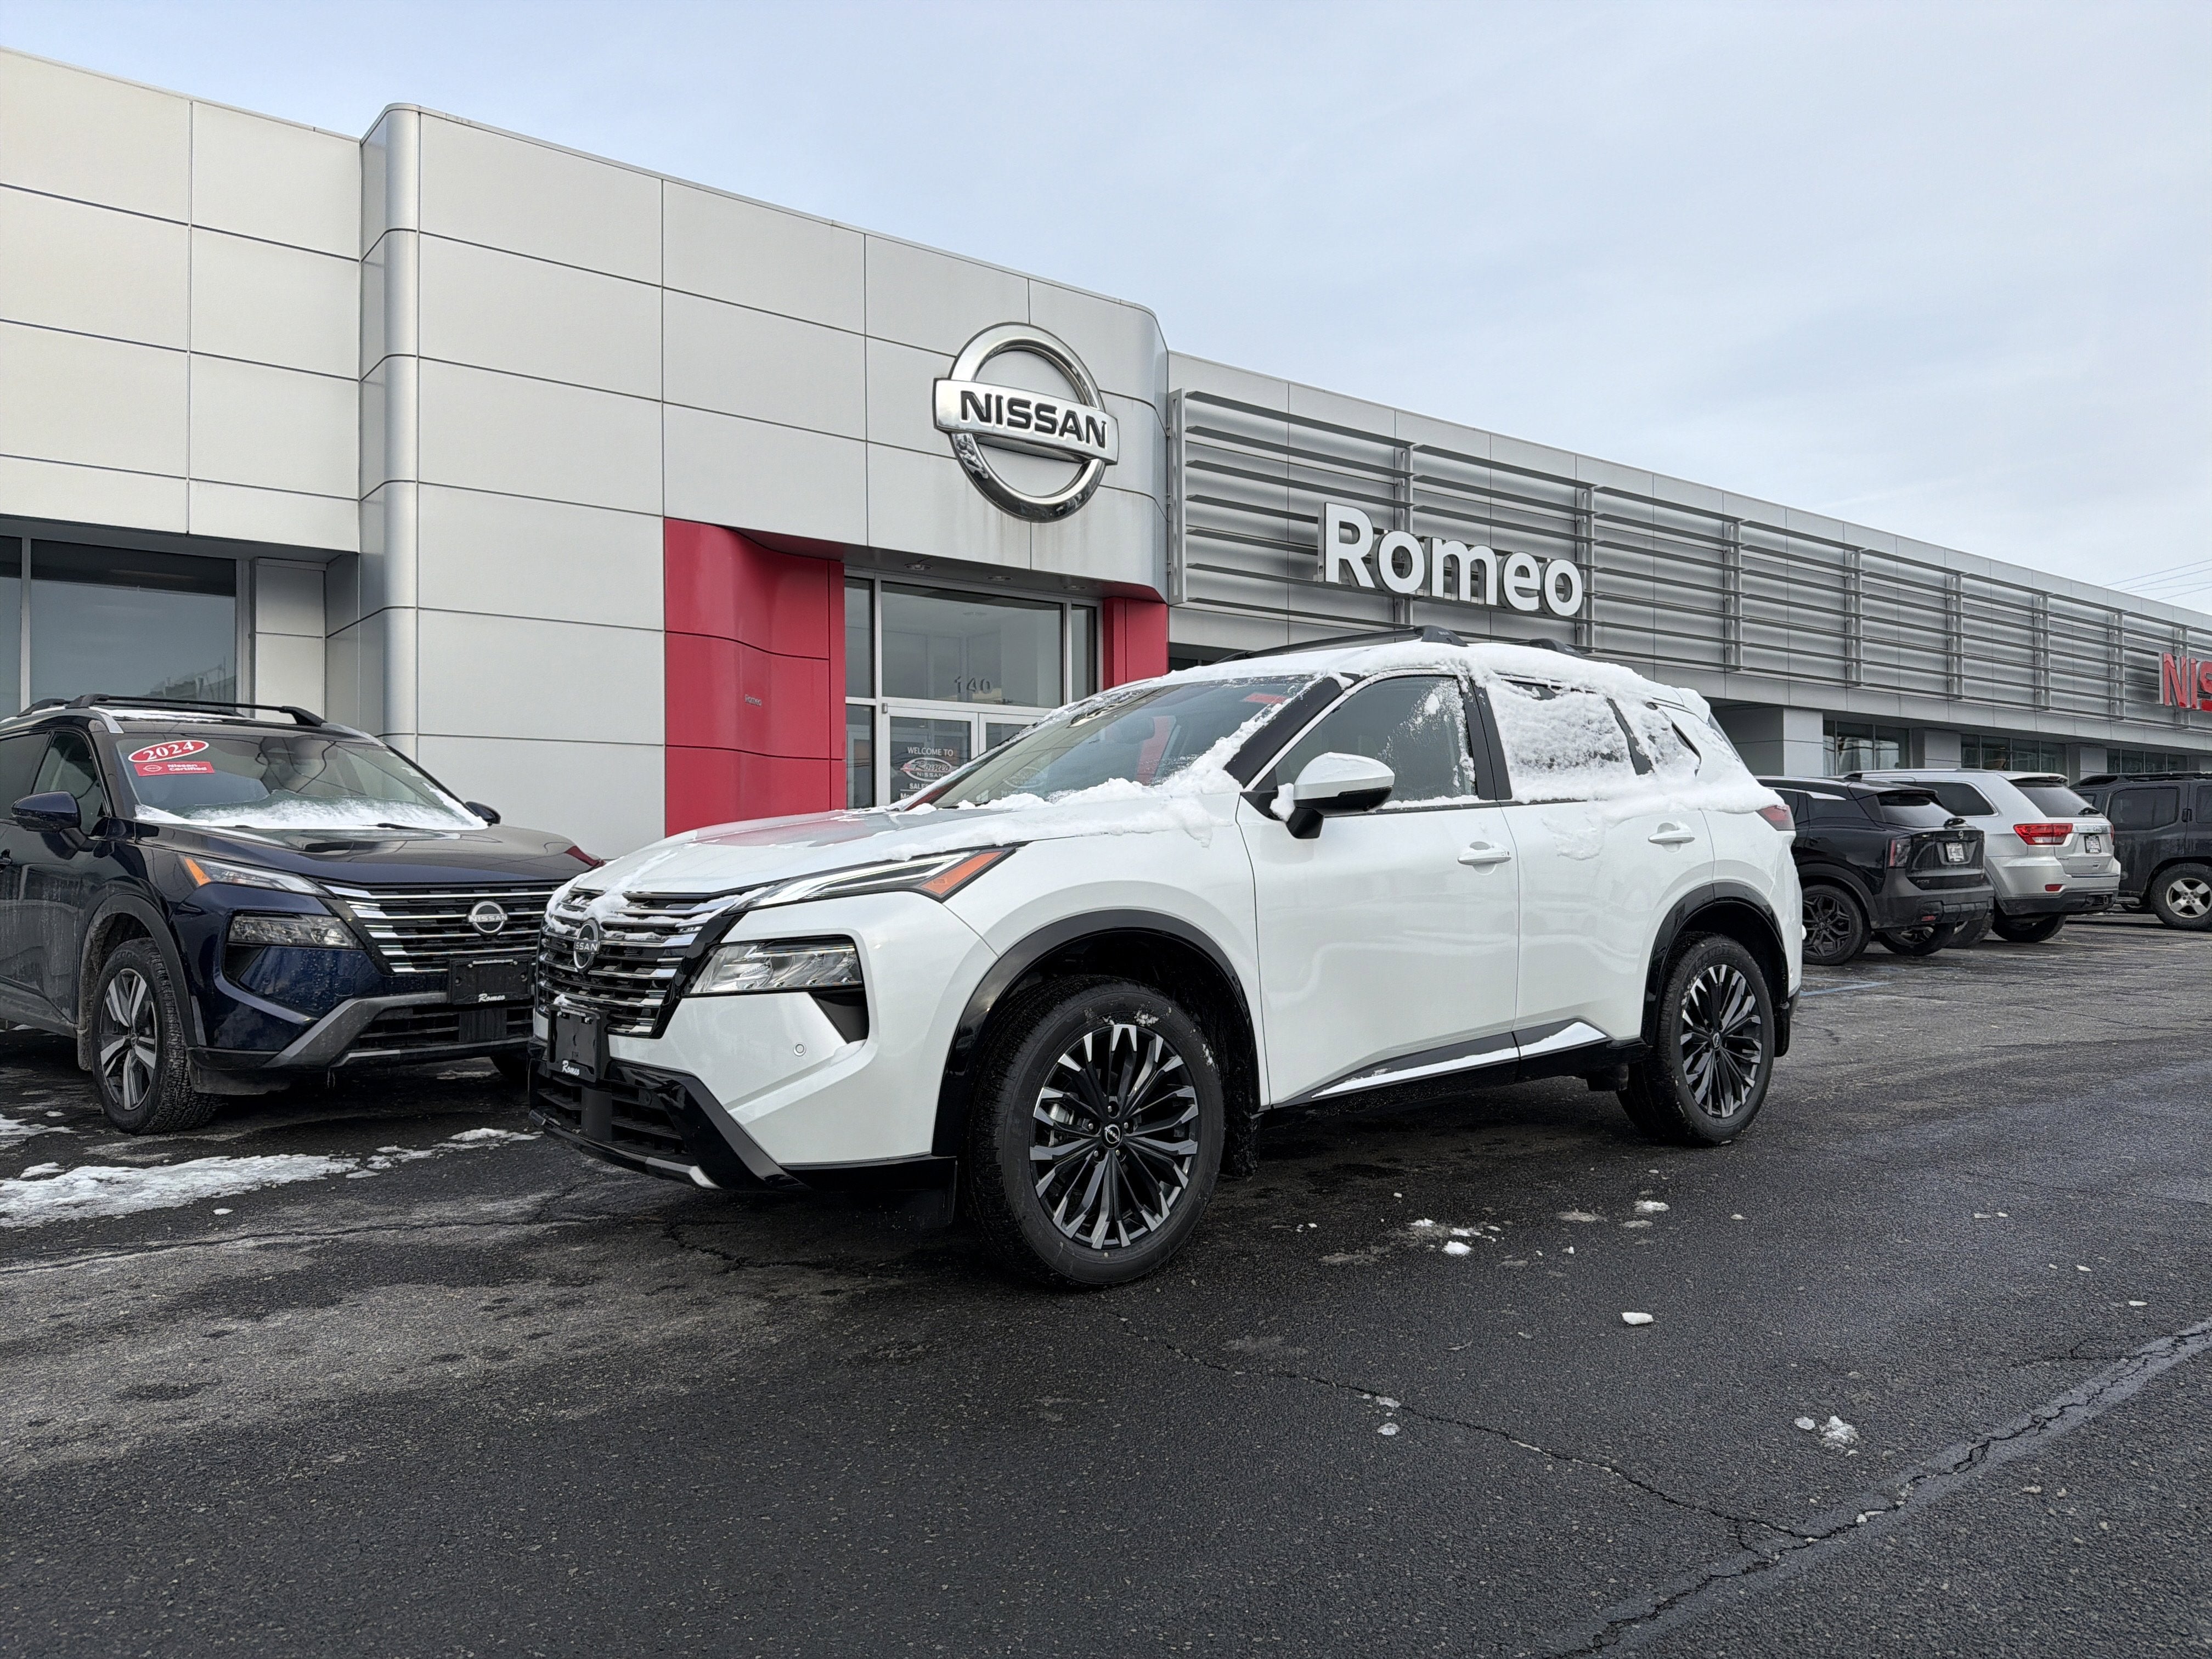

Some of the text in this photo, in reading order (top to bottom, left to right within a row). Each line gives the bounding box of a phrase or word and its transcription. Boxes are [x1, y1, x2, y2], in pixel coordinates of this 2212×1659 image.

[961, 390, 1107, 449] NISSAN
[1324, 501, 1583, 616] Romeo
[143, 741, 194, 760] 2024
[907, 747, 942, 755] WELCOME
[913, 759, 950, 772] Romeo
[478, 993, 506, 1002] Romeo
